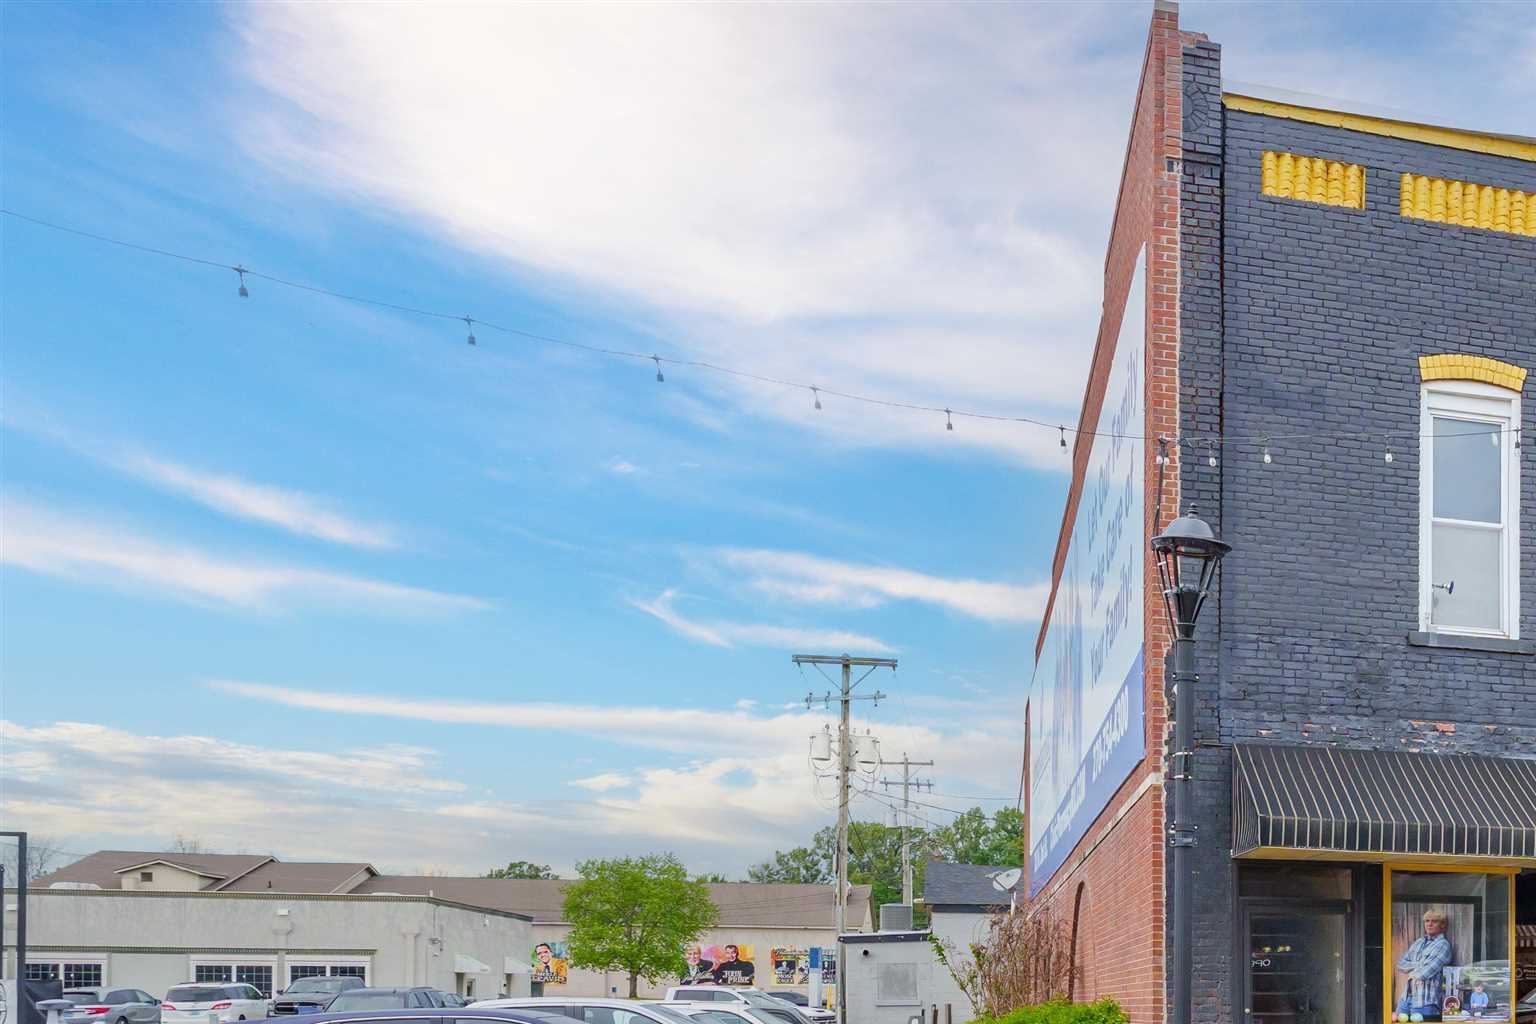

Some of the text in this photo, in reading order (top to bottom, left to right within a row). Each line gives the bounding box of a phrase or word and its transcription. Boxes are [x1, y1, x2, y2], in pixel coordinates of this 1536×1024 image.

[1087, 347, 1138, 554] Let Our Family
[1090, 443, 1134, 617] Take Care of
[1090, 543, 1133, 689] Your Family!
